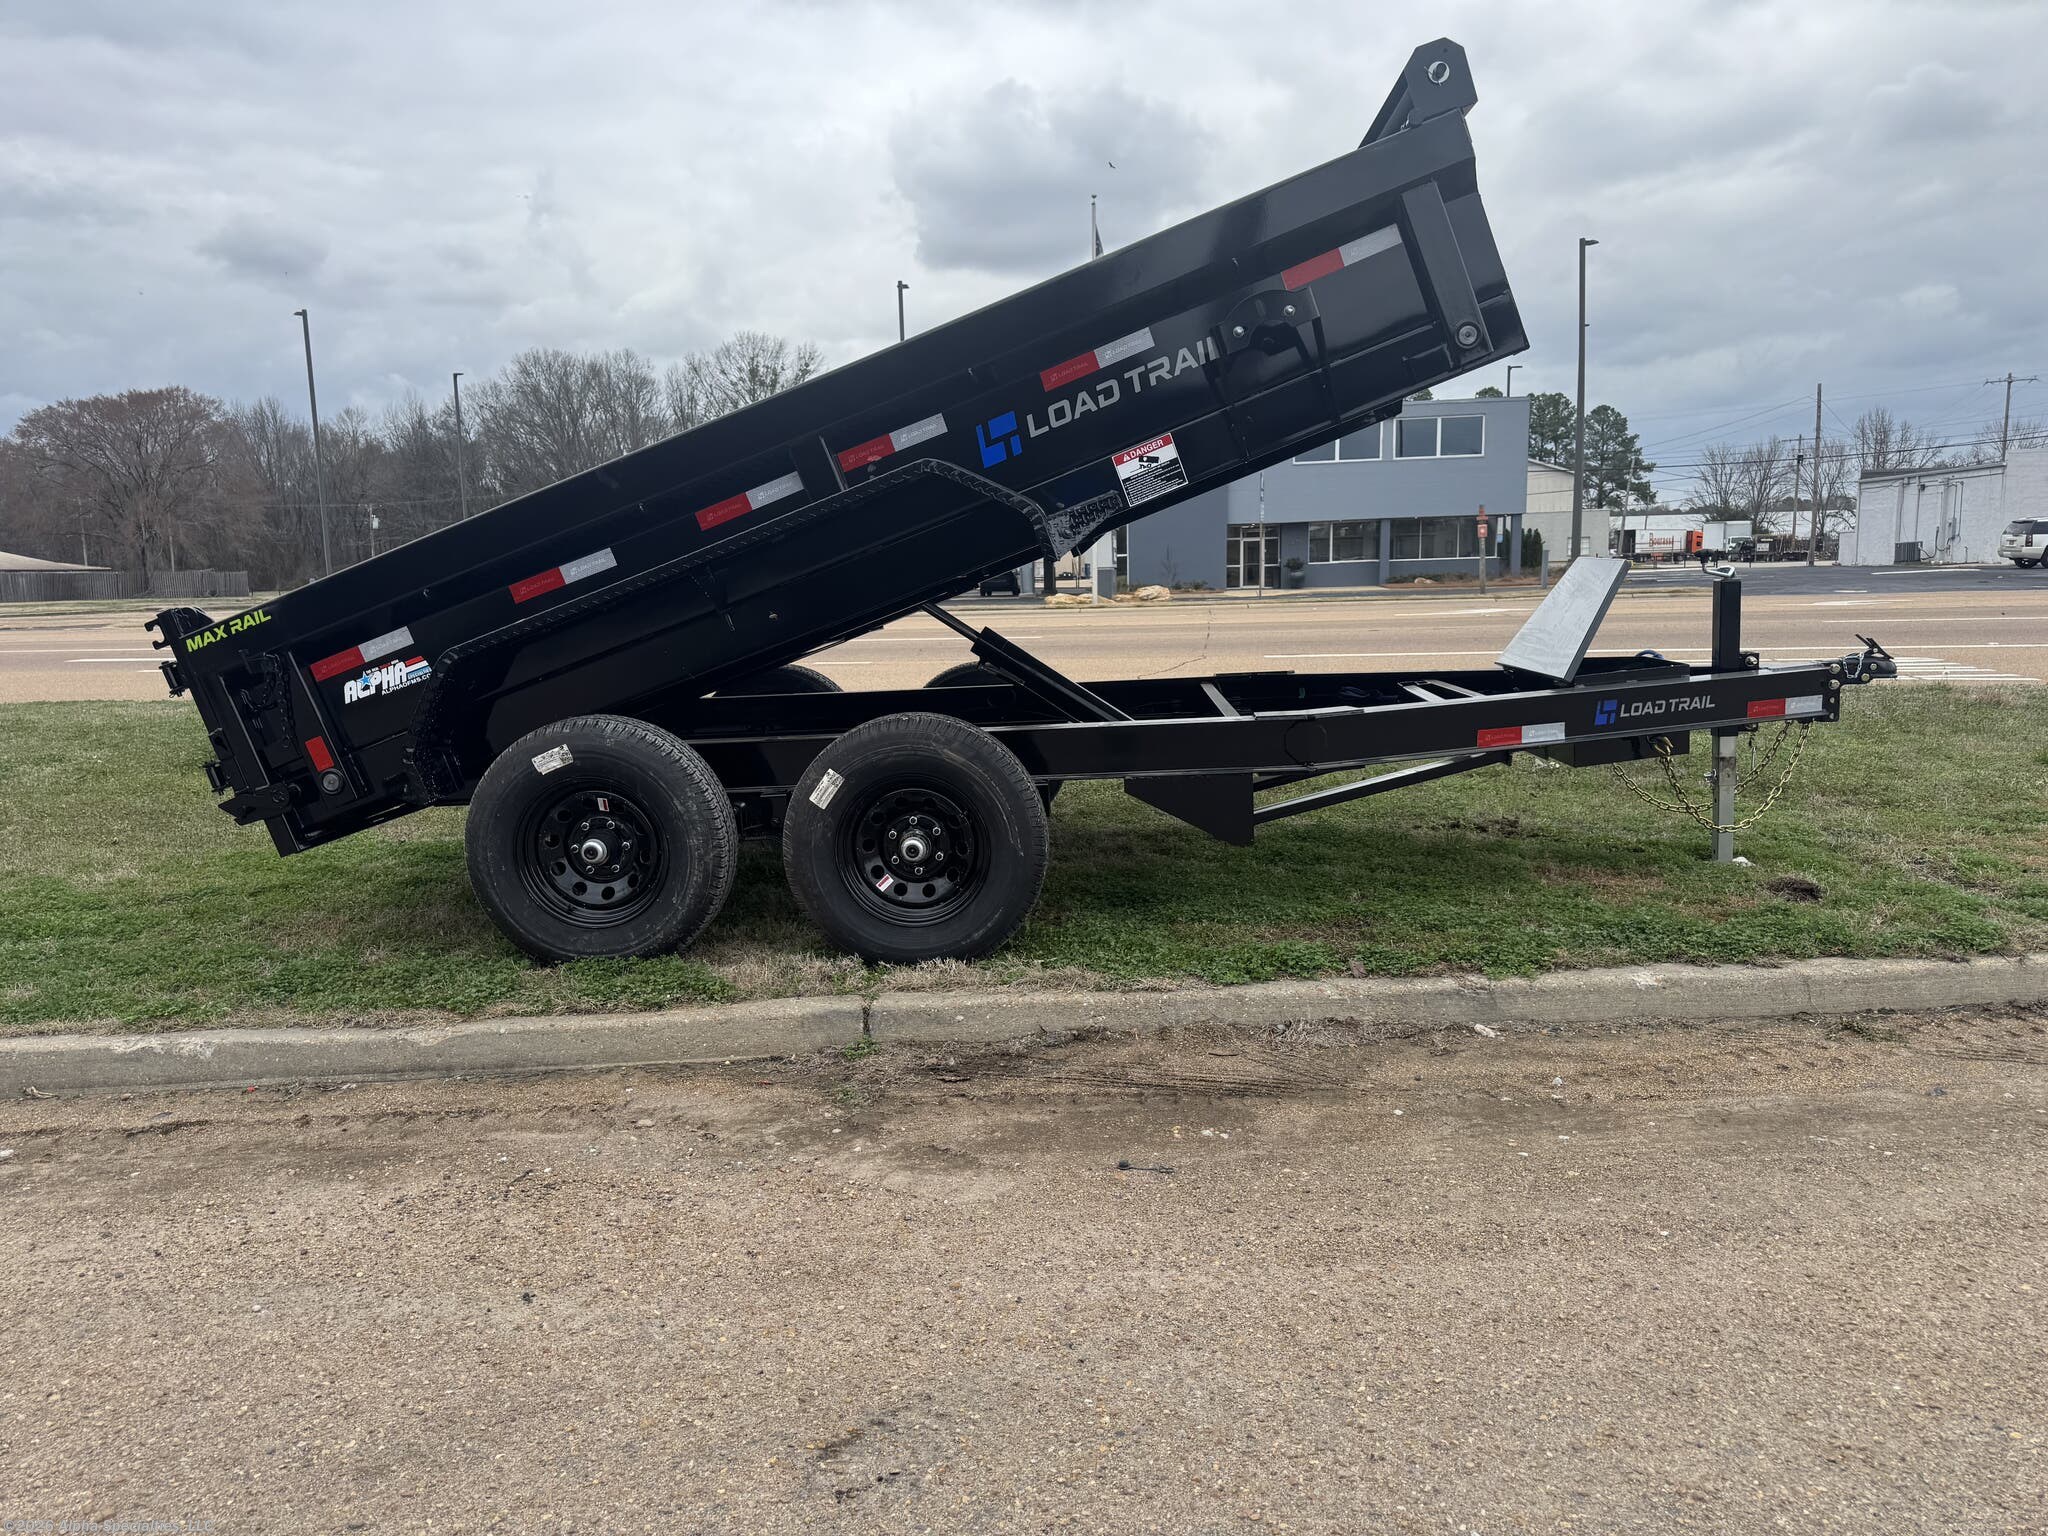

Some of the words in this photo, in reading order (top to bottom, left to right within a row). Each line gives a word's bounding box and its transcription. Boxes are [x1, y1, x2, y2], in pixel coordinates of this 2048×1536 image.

[1026, 379, 1120, 438] LOAD
[1129, 439, 1164, 459] DANGER
[185, 625, 228, 652] MAX
[228, 609, 272, 634] RAIL
[344, 661, 407, 704] ALPHA
[1619, 700, 1667, 718] LOAD
[1669, 695, 1716, 712] TRAIL
